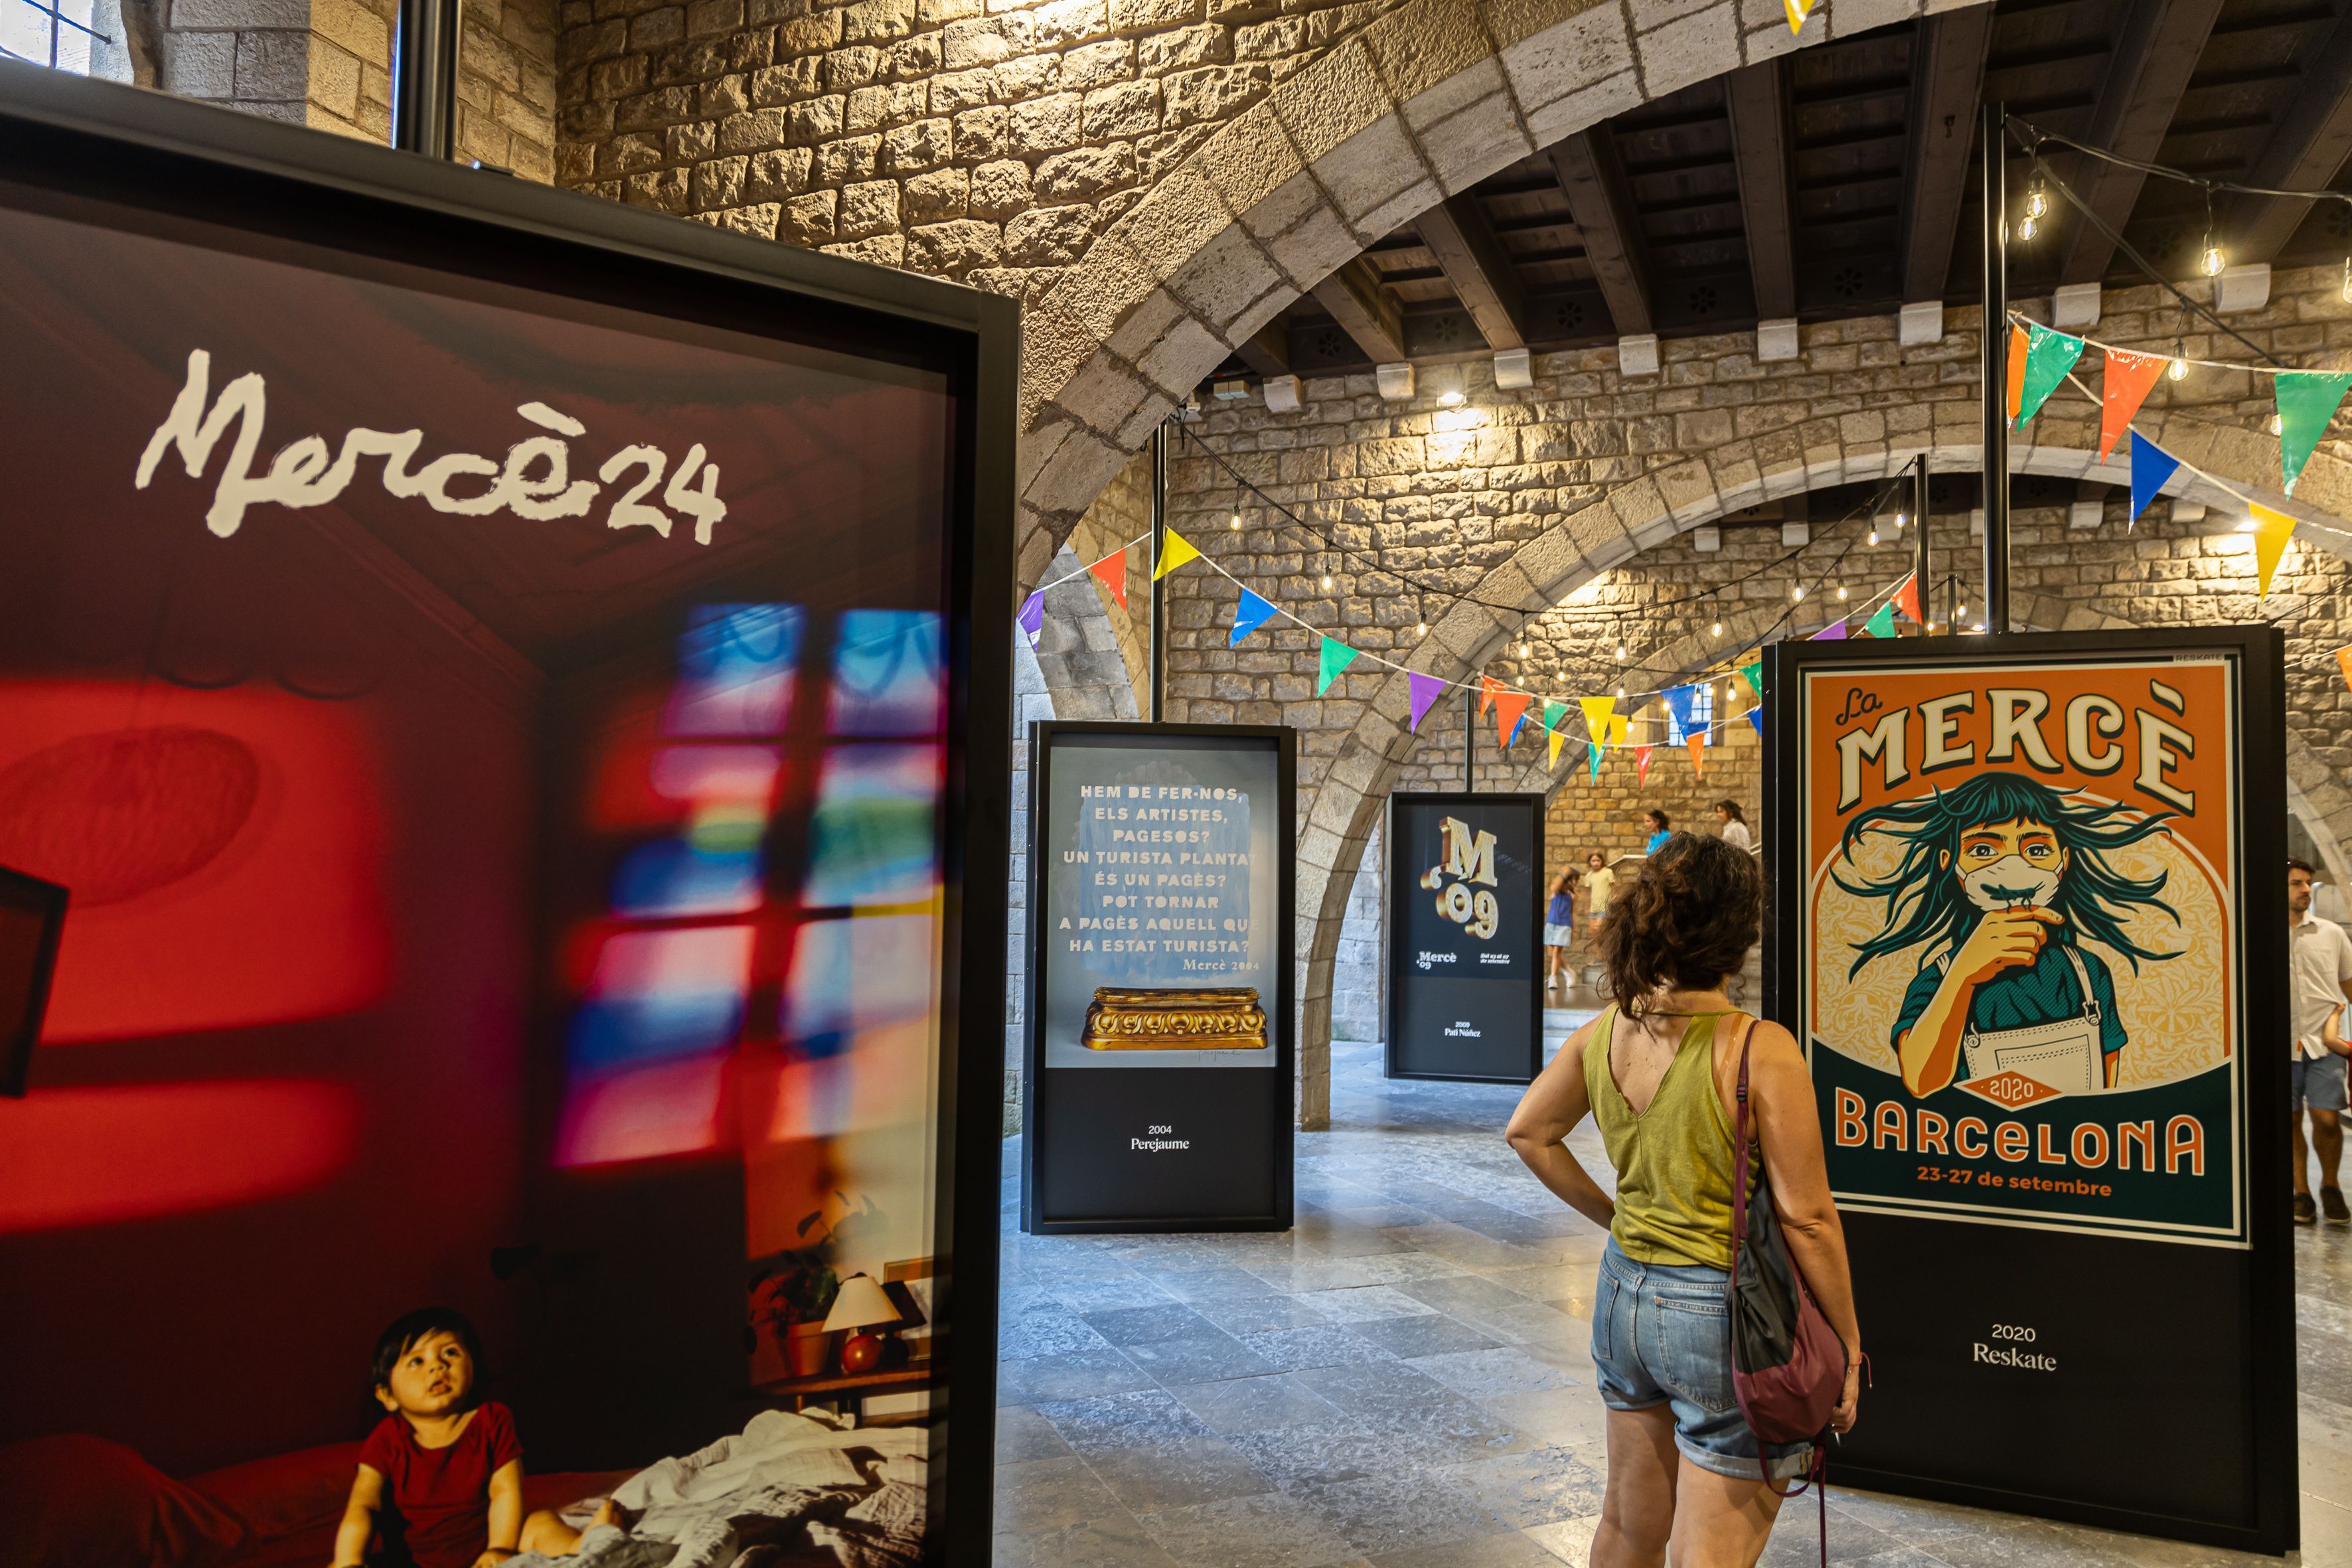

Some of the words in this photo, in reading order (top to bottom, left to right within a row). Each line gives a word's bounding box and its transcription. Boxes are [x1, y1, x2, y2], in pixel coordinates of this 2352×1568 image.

[1836, 687, 1883, 726] La
[1836, 678, 2195, 817] MERCÈ
[1081, 785, 1120, 797] HEM
[1129, 786, 1151, 799] DE
[1159, 787, 1243, 804] FER-NOS,
[1095, 807, 1128, 821] ELS
[1136, 808, 1227, 824] ARTISTES,
[1113, 829, 1209, 843] PAGESOS?
[1064, 851, 1088, 863] UN
[1096, 851, 1172, 864] TURISTA
[1180, 852, 1257, 866] PLANTAT
[1095, 871, 1117, 886] ÉS
[1125, 874, 1149, 886] UN
[1158, 872, 1226, 888] PAGÈS?
[1103, 896, 1137, 908] POT
[1145, 896, 1219, 909] TORNAR
[1059, 917, 1071, 929] A
[1079, 915, 1138, 930] PAGÈS
[1146, 917, 1216, 931] AQUELL
[1223, 918, 1259, 932] QUE
[1070, 939, 1093, 952] HA
[1102, 940, 1156, 952] ESTAT
[1163, 940, 1249, 953] TURISTA?
[1182, 959, 1225, 971] Mercè
[1231, 961, 1259, 971] 2004
[1419, 951, 1456, 962] Mercè
[1990, 1078, 2034, 1102] 2020
[1148, 1125, 1172, 1134] 2004
[1131, 1138, 1190, 1152] Perejaume
[1917, 1166, 1973, 1184] 23-27
[1978, 1172, 2003, 1187] de
[2009, 1176, 2112, 1196] setembre
[1992, 1324, 2036, 1342] 2020
[1974, 1342, 2057, 1372] Reskate
